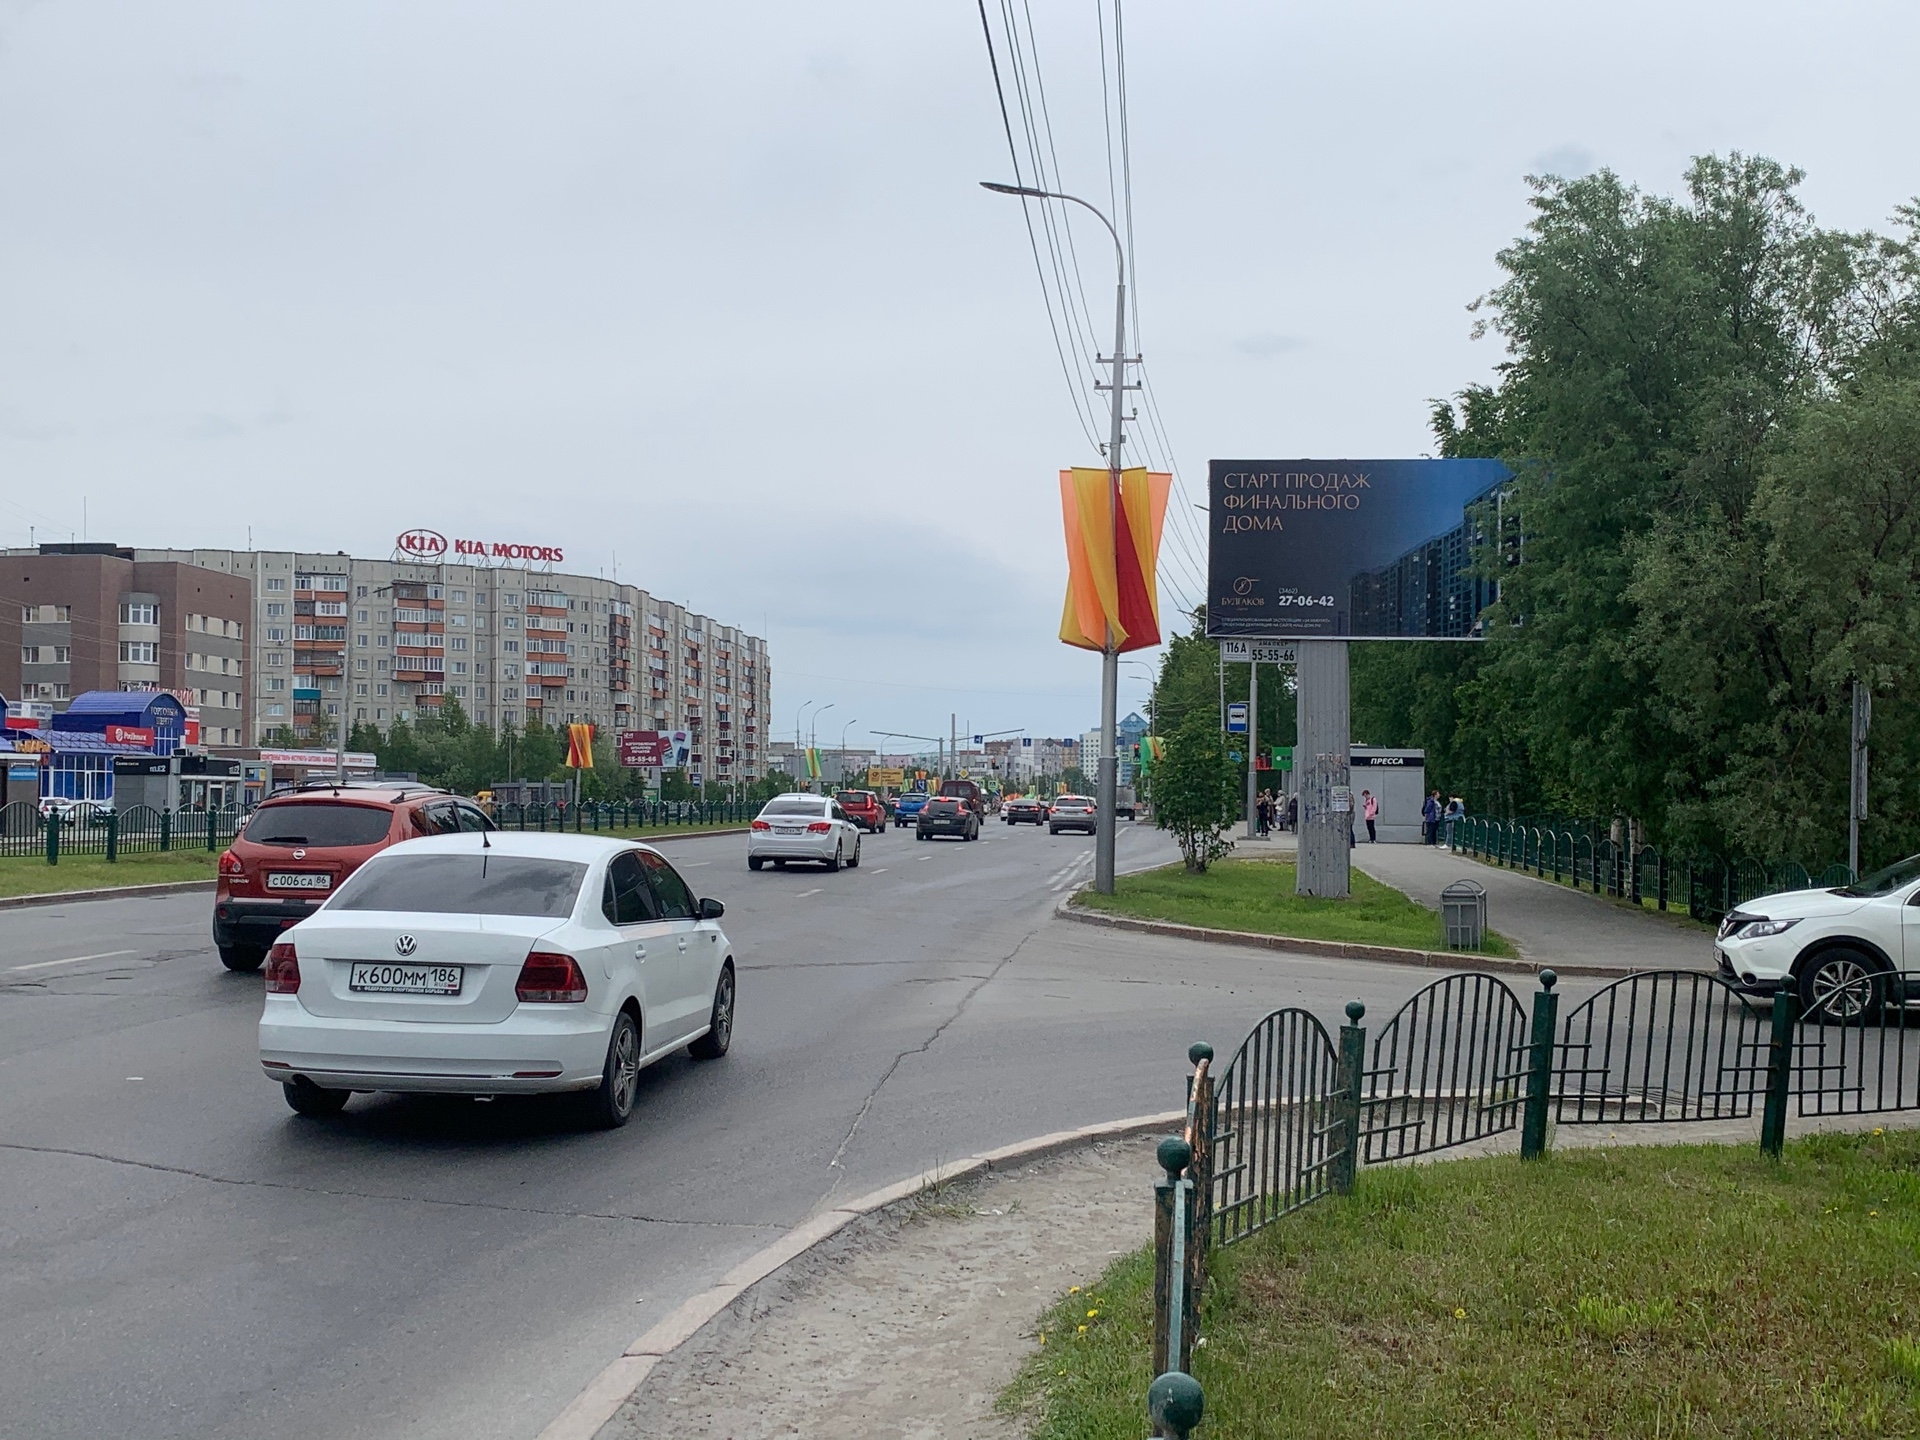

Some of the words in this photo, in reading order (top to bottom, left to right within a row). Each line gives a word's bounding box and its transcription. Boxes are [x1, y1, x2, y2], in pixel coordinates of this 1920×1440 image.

[1223, 472, 1281, 489] СТАРТ
[1285, 473, 1371, 491] ПРОДАЖ
[1223, 494, 1360, 510] ФИНАЛЬНОГО
[1223, 515, 1284, 534] ДОМА
[405, 534, 440, 552] KIA
[454, 539, 487, 556] KIA
[492, 543, 564, 562] MOTORS
[1278, 587, 1299, 595] (3462)
[1221, 597, 1265, 606] БУЛГАКОВ
[1278, 596, 1335, 607] 27-06-42
[1252, 649, 1295, 661] 55-55-66
[1370, 757, 1404, 766] ПРЕССА
[272, 875, 313, 887] С006СА
[315, 875, 327, 885] 86
[357, 966, 427, 987] К600ММ
[430, 968, 456, 983] 186
